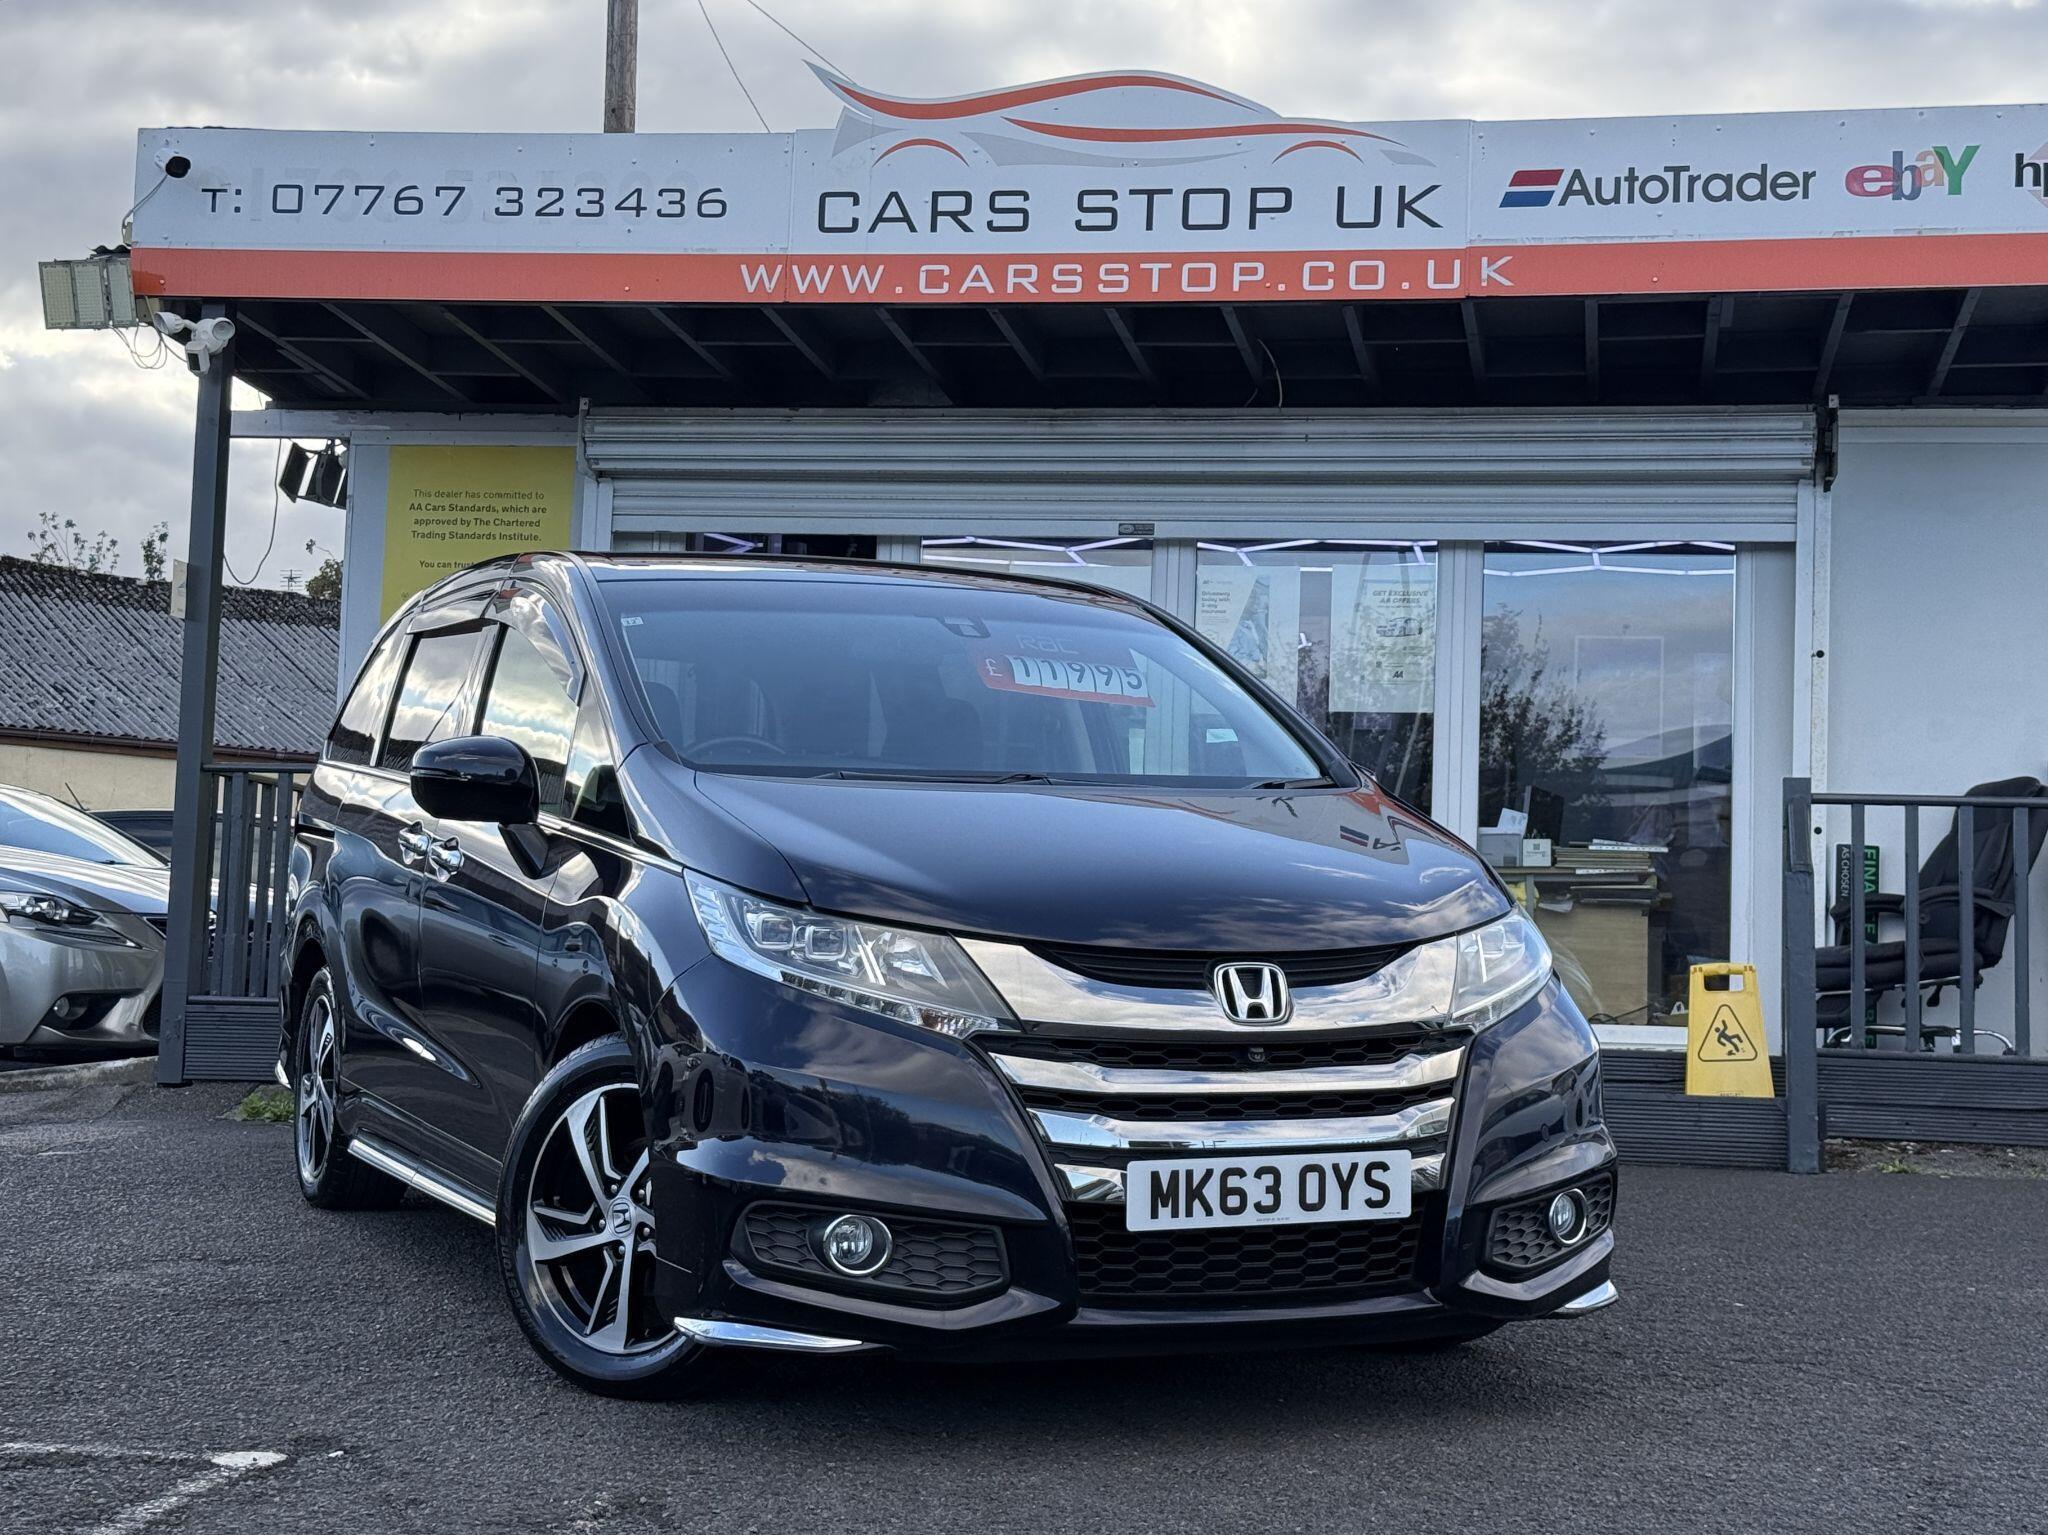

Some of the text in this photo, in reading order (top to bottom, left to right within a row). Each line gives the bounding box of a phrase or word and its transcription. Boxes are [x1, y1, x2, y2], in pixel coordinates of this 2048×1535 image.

[1557, 164, 1817, 207] AutoTrader
[201, 187, 243, 214] T:
[271, 184, 467, 216] 07767
[494, 186, 729, 219] 323436
[817, 184, 1445, 235] CARS STOP UK
[740, 254, 1516, 295] WWW.CARSSTOP.CO.UK
[413, 489, 545, 500] This dealer has committed to
[409, 502, 548, 514] AA Cars Standards, which are
[413, 517, 541, 528] approved by The Chartered
[411, 530, 542, 542] Trading Standards Institute.
[419, 560, 435, 569] You
[1150, 1161, 1391, 1220] MK63 OYS
